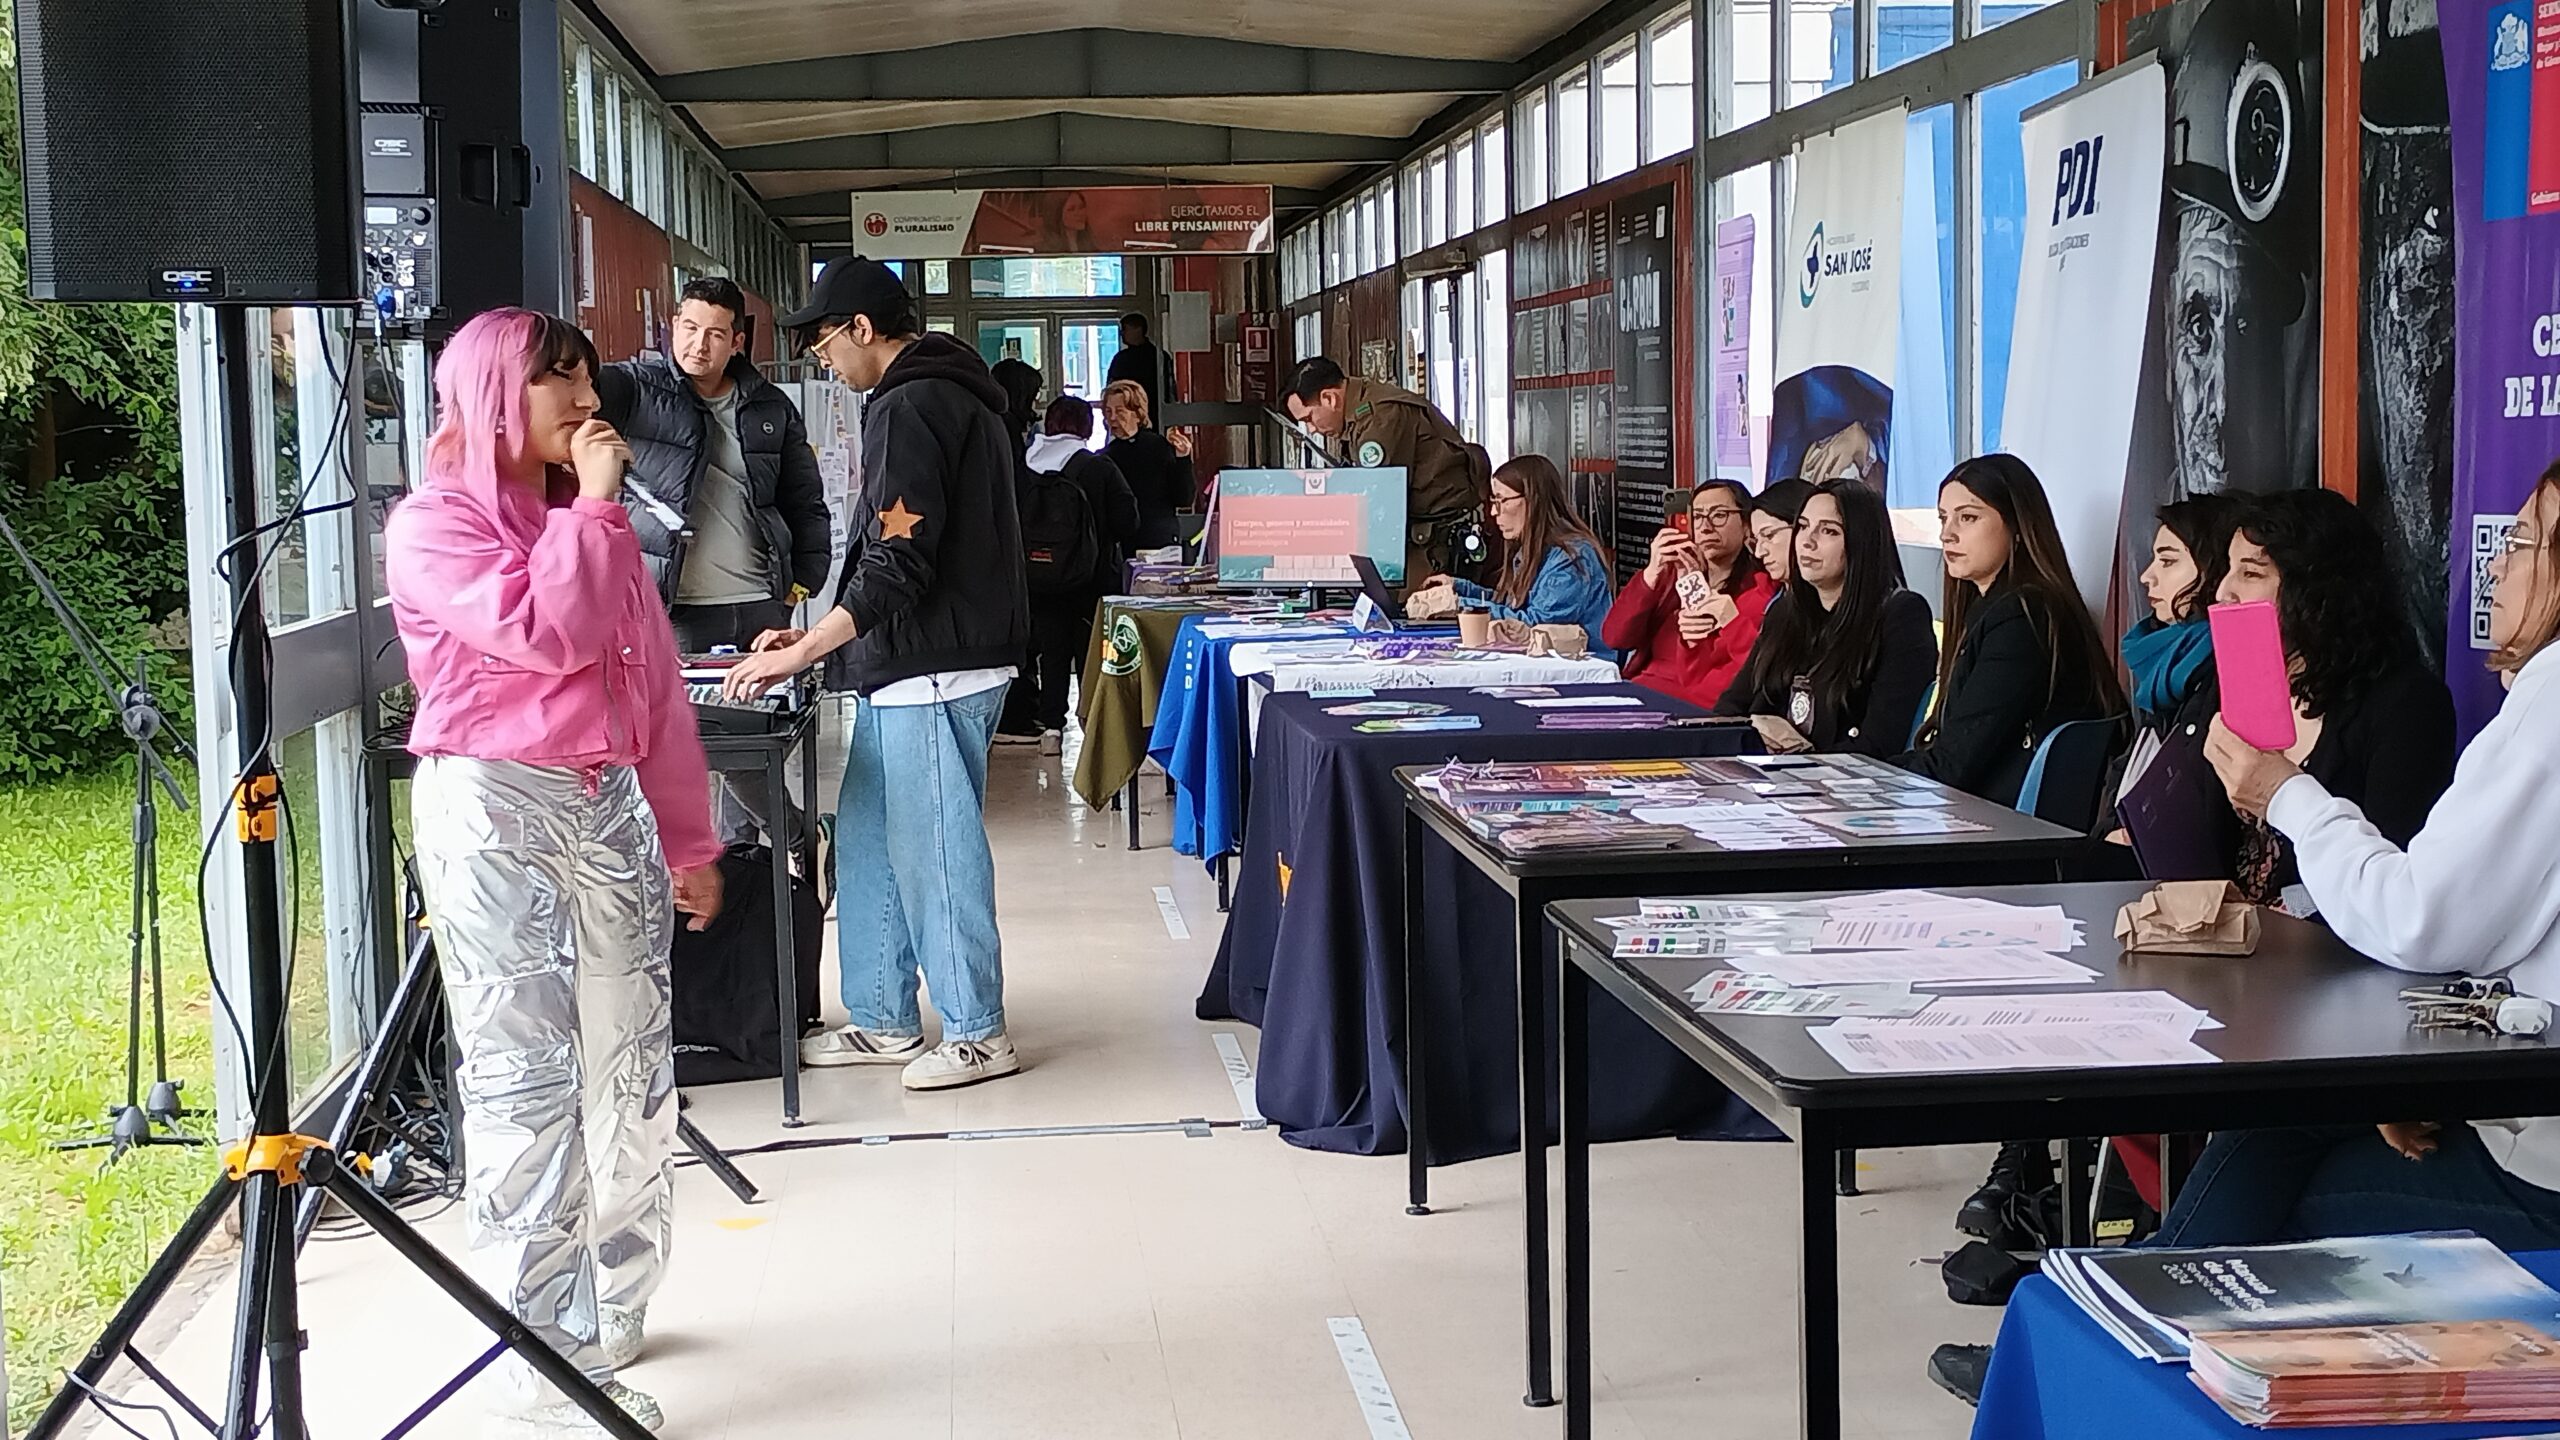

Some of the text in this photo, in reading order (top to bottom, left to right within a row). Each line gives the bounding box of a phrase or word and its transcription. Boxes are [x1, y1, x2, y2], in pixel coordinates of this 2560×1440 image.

[2051, 134, 2103, 227] PDI
[1170, 204, 1260, 218] EJERCITAMOS EL
[894, 223, 955, 233] PLURALISMO
[1134, 220, 1258, 232] LIBRE PENSAMIENTO
[1824, 238, 1873, 277] SAN JOSÉ
[163, 270, 213, 282] QSC
[2504, 376, 2536, 418] DE
[2225, 1259, 2279, 1294] Manual
